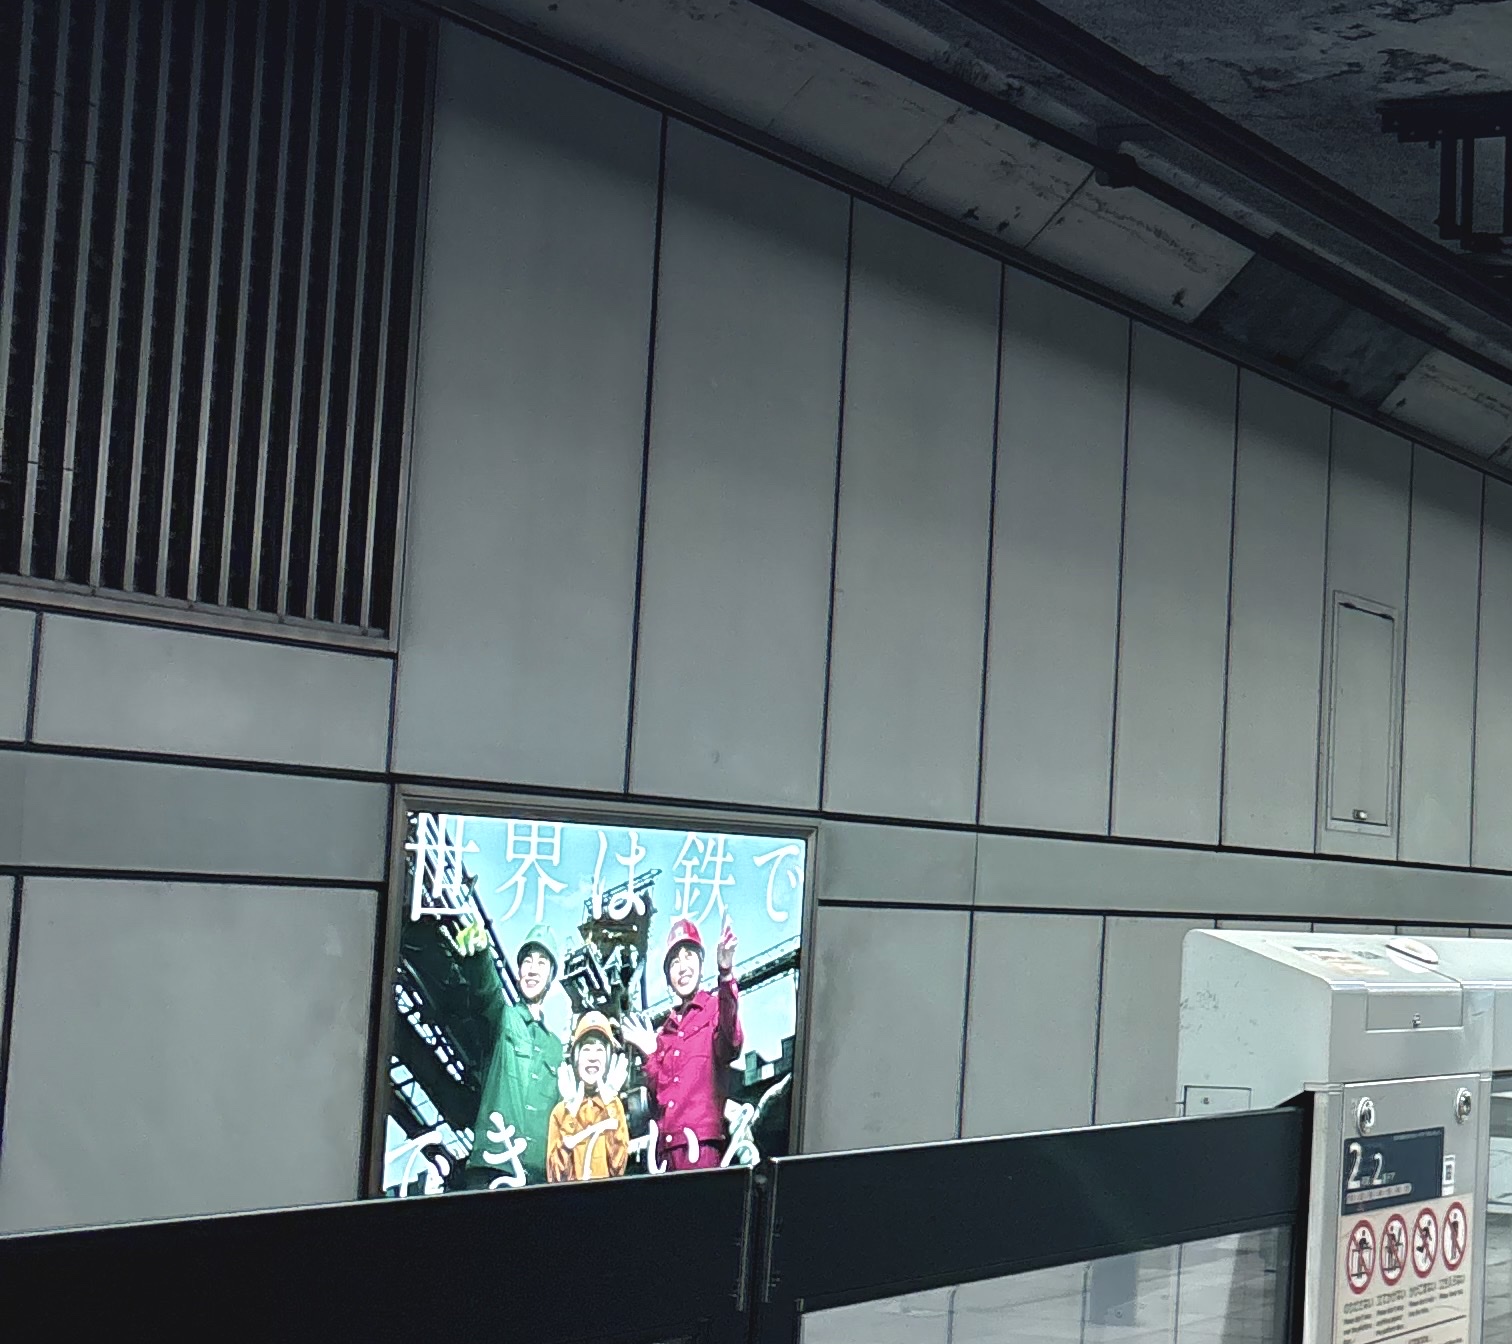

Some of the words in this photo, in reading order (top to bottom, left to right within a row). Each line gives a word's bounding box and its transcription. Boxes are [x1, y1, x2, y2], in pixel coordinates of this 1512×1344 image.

[404, 812, 804, 923] 世界は鉄で
